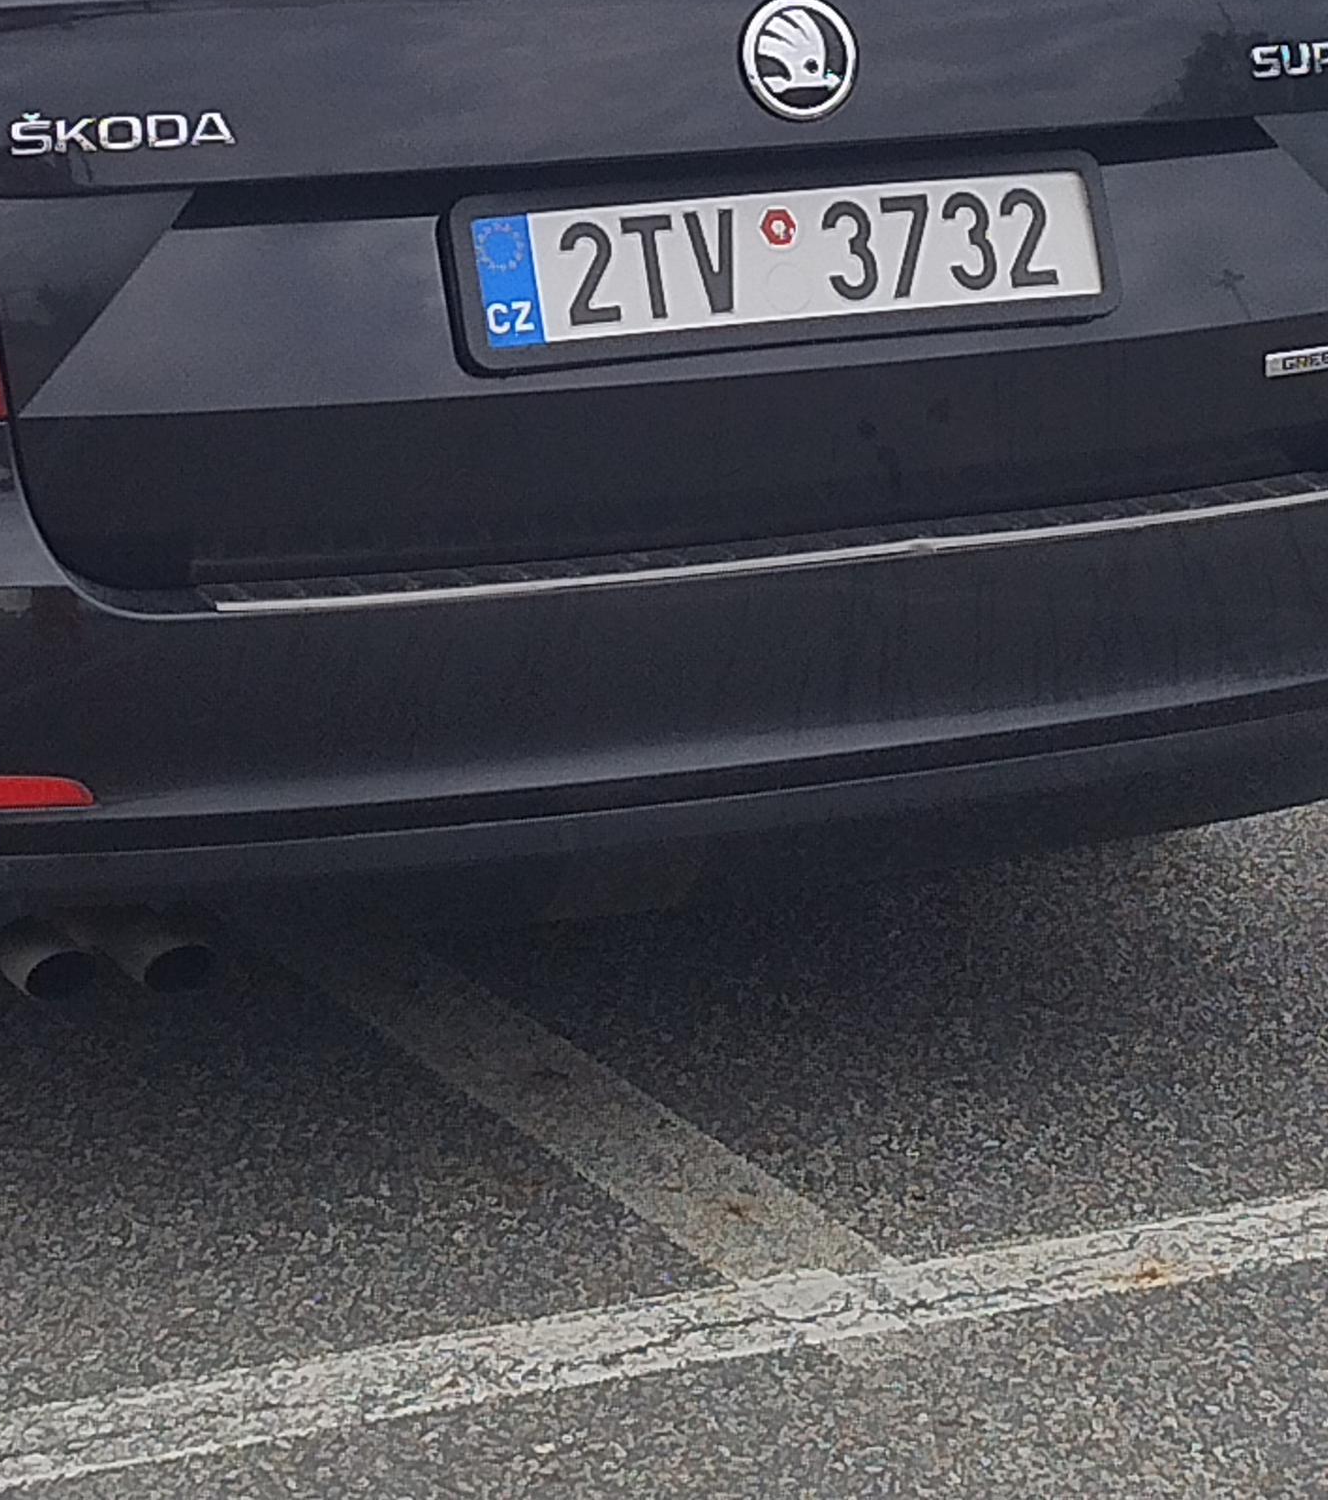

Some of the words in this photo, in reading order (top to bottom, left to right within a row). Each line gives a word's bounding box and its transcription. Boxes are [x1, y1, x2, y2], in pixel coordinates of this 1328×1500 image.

[10, 112, 235, 155] ŠKODA
[559, 208, 735, 327] 2TV
[821, 187, 1059, 301] 3732
[487, 301, 535, 335] CZ
